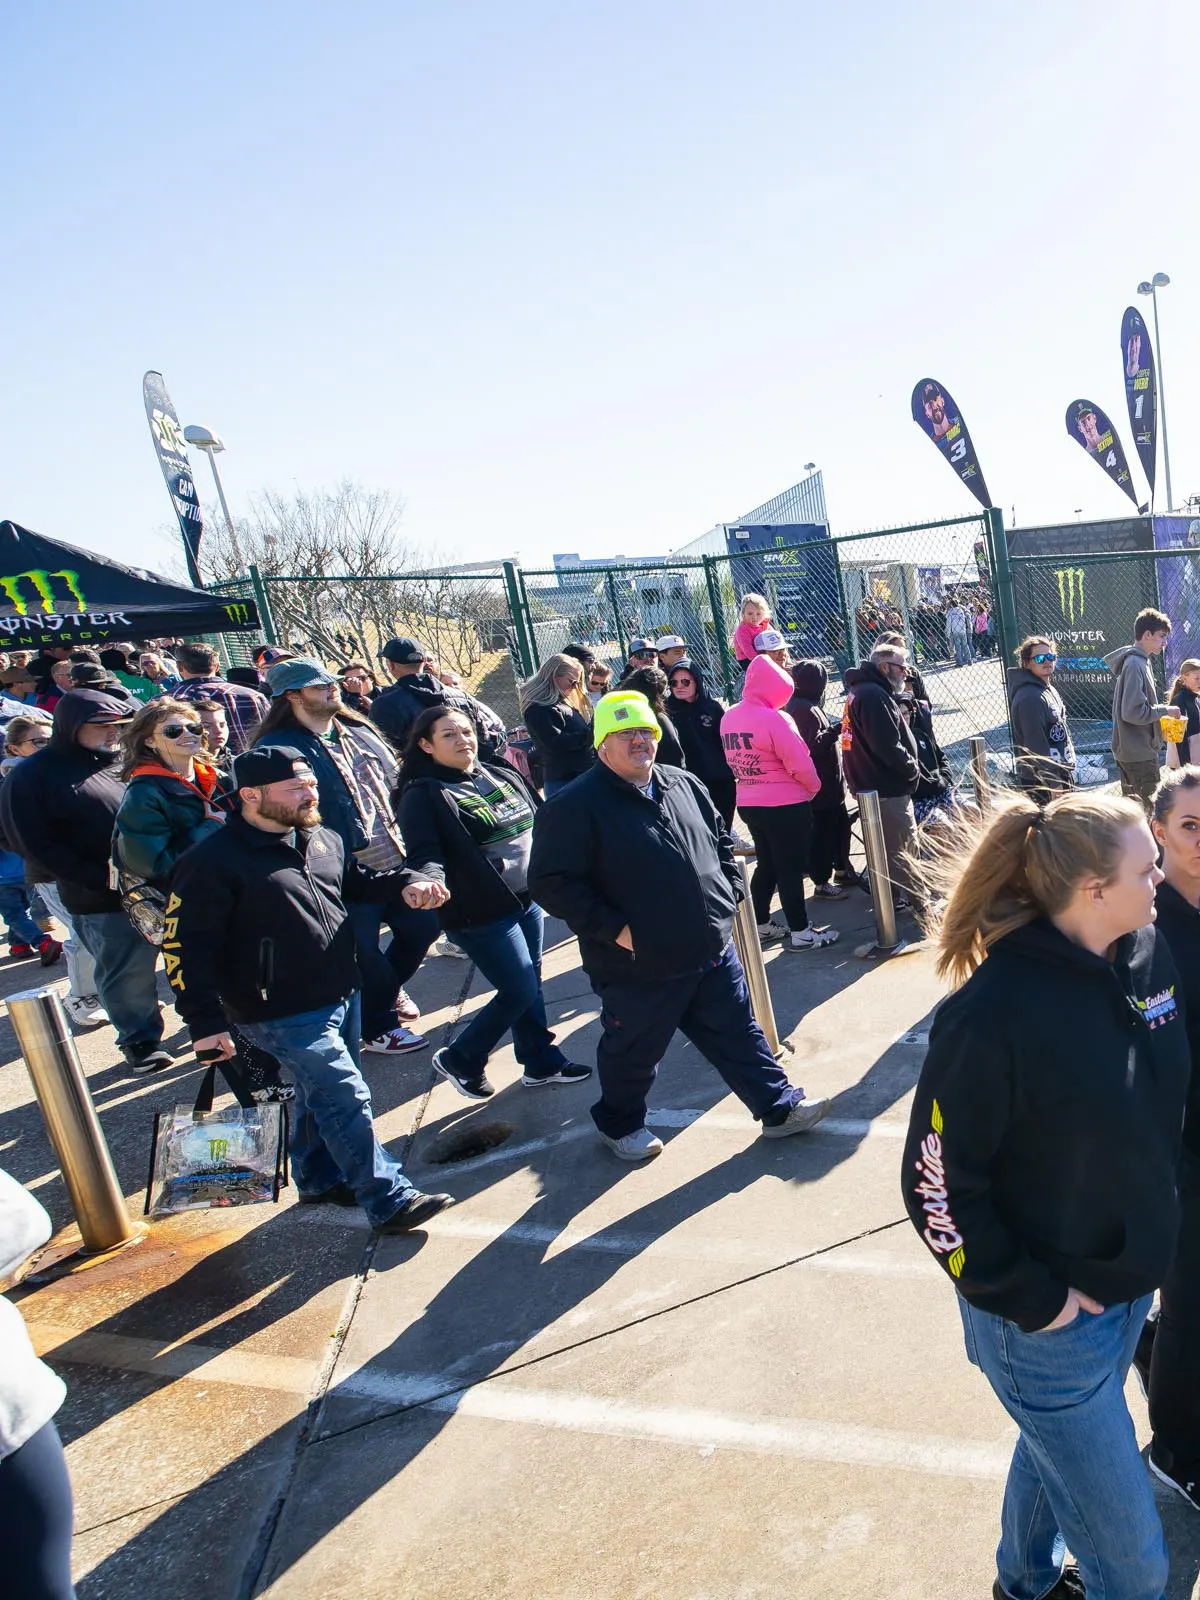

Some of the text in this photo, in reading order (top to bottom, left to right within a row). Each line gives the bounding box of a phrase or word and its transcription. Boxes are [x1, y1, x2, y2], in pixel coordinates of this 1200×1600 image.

[1135, 395, 1144, 419] 1
[951, 438, 967, 463] 3
[1105, 449, 1117, 468] 4
[0, 612, 133, 635] ONSTER
[0, 630, 109, 646] ENERGY
[1045, 628, 1106, 643] MONSTER
[1058, 644, 1096, 652] NERGY
[1049, 672, 1113, 684] HAMPIONSHIP
